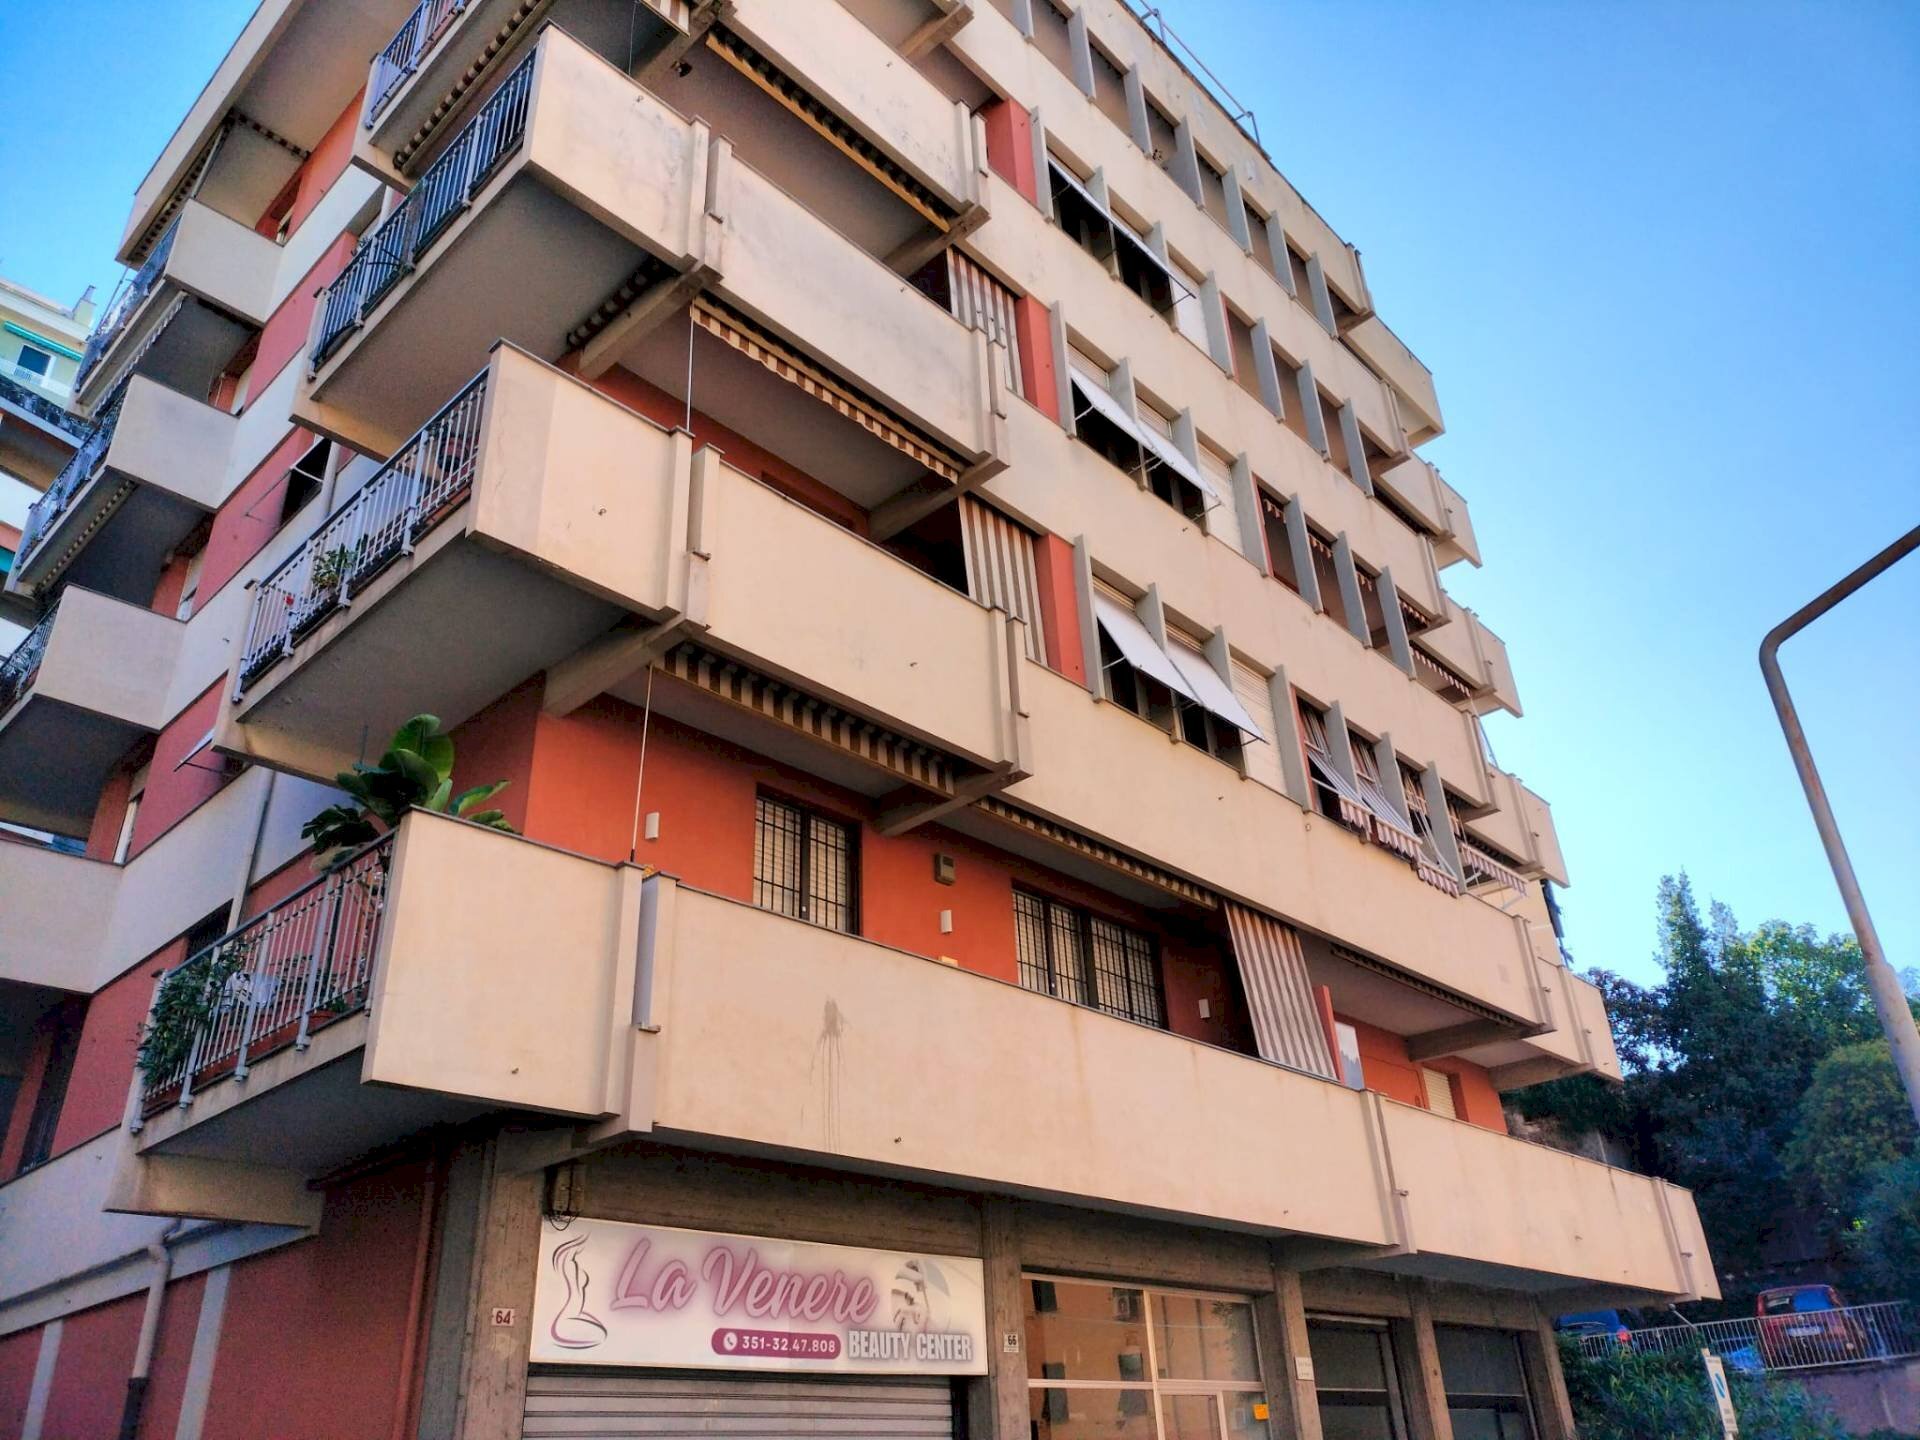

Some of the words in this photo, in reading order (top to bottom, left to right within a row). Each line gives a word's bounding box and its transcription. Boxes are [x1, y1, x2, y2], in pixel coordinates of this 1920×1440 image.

[610, 1238, 697, 1312] La
[702, 1246, 878, 1323] Venere
[495, 1310, 511, 1324] 64
[742, 1335, 836, 1353] 351-32.47.808
[849, 1330, 912, 1360] BEAUTY
[916, 1333, 973, 1361] CENTER
[1007, 1334, 1017, 1346] 66
